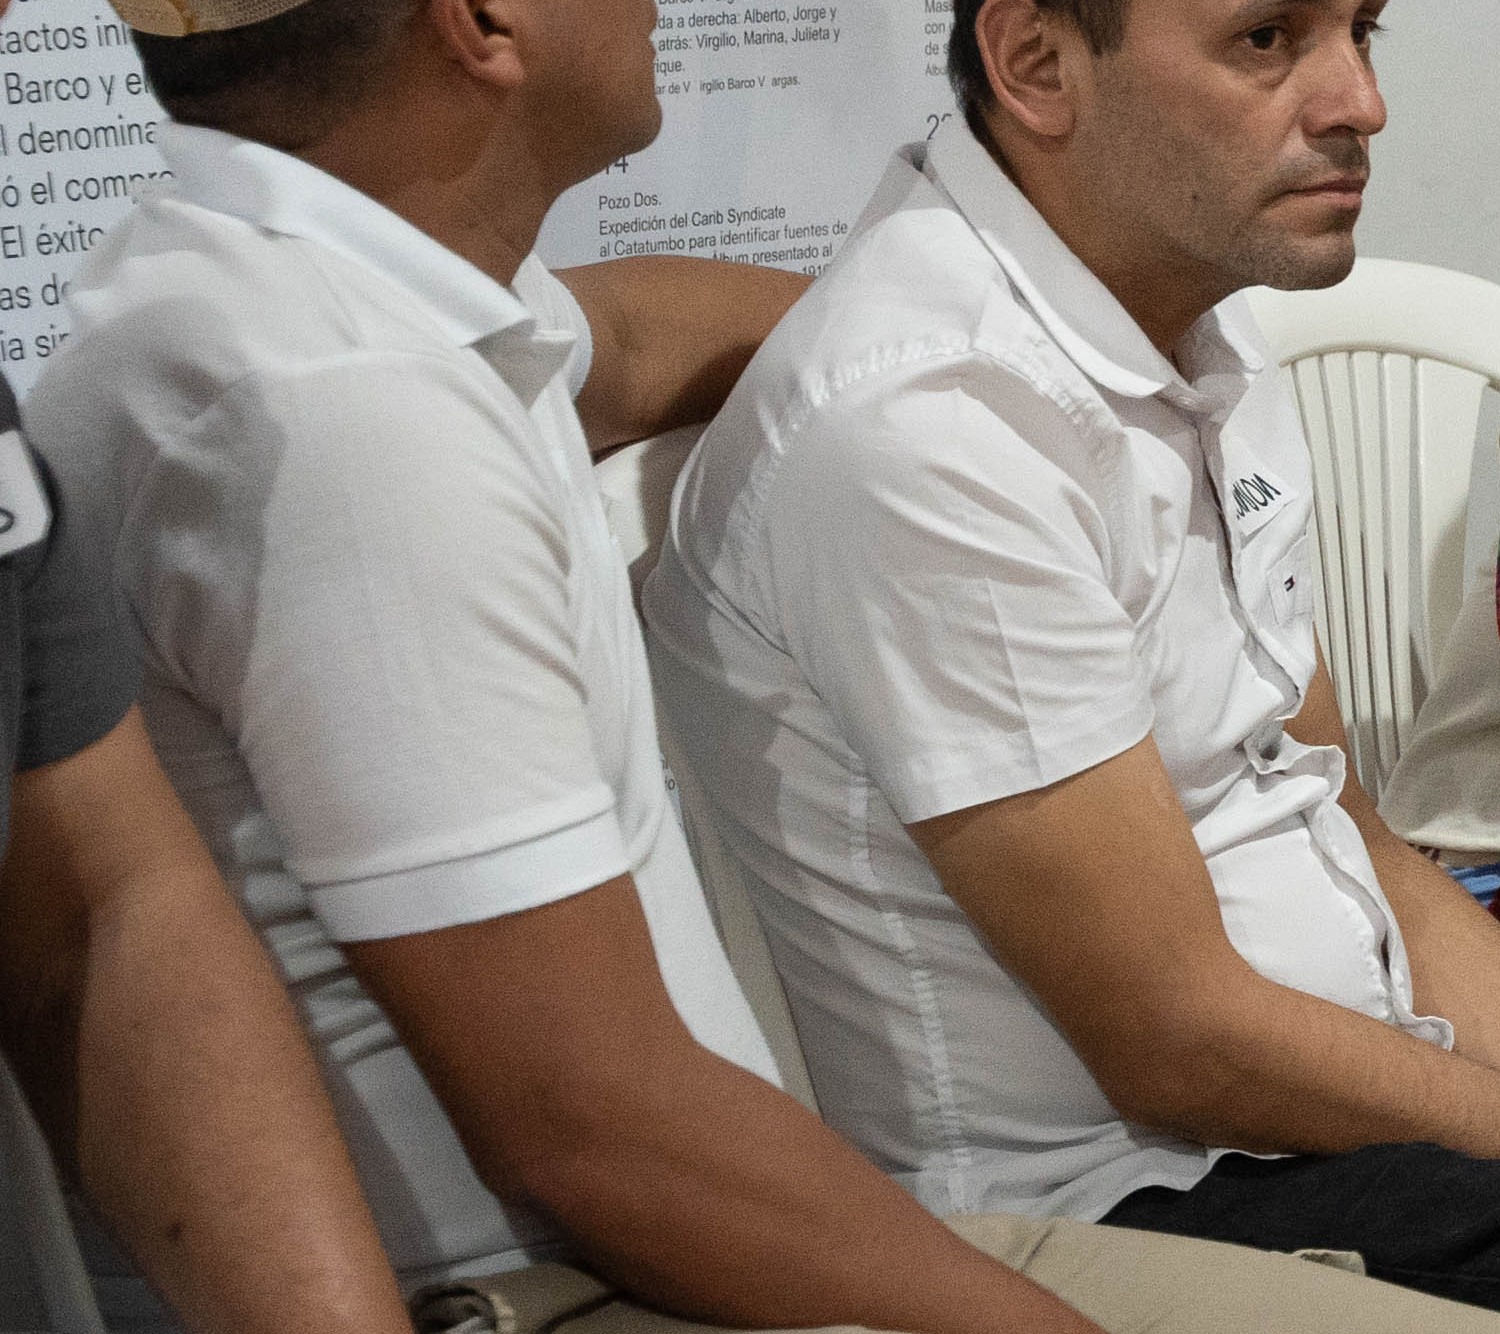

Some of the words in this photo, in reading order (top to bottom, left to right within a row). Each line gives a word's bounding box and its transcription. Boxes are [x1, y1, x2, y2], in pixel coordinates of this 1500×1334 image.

[792, 5, 827, 23] Jorge
[657, 35, 692, 53] atrás:
[695, 31, 740, 52] Virgilio,
[791, 26, 831, 43] Julieta
[3, 71, 91, 106] Barco
[98, 74, 116, 107] y
[30, 171, 56, 206] el
[598, 194, 632, 211] Pozo
[598, 215, 667, 238] Expedición
[668, 213, 689, 230] del
[726, 205, 788, 227] Syndicate
[598, 241, 611, 258] al
[613, 237, 687, 258] Catatumbo
[688, 235, 718, 255] para
[719, 227, 781, 246] identificar
[783, 223, 827, 240] fuentes
[831, 219, 850, 238] de
[0, 224, 26, 260] El
